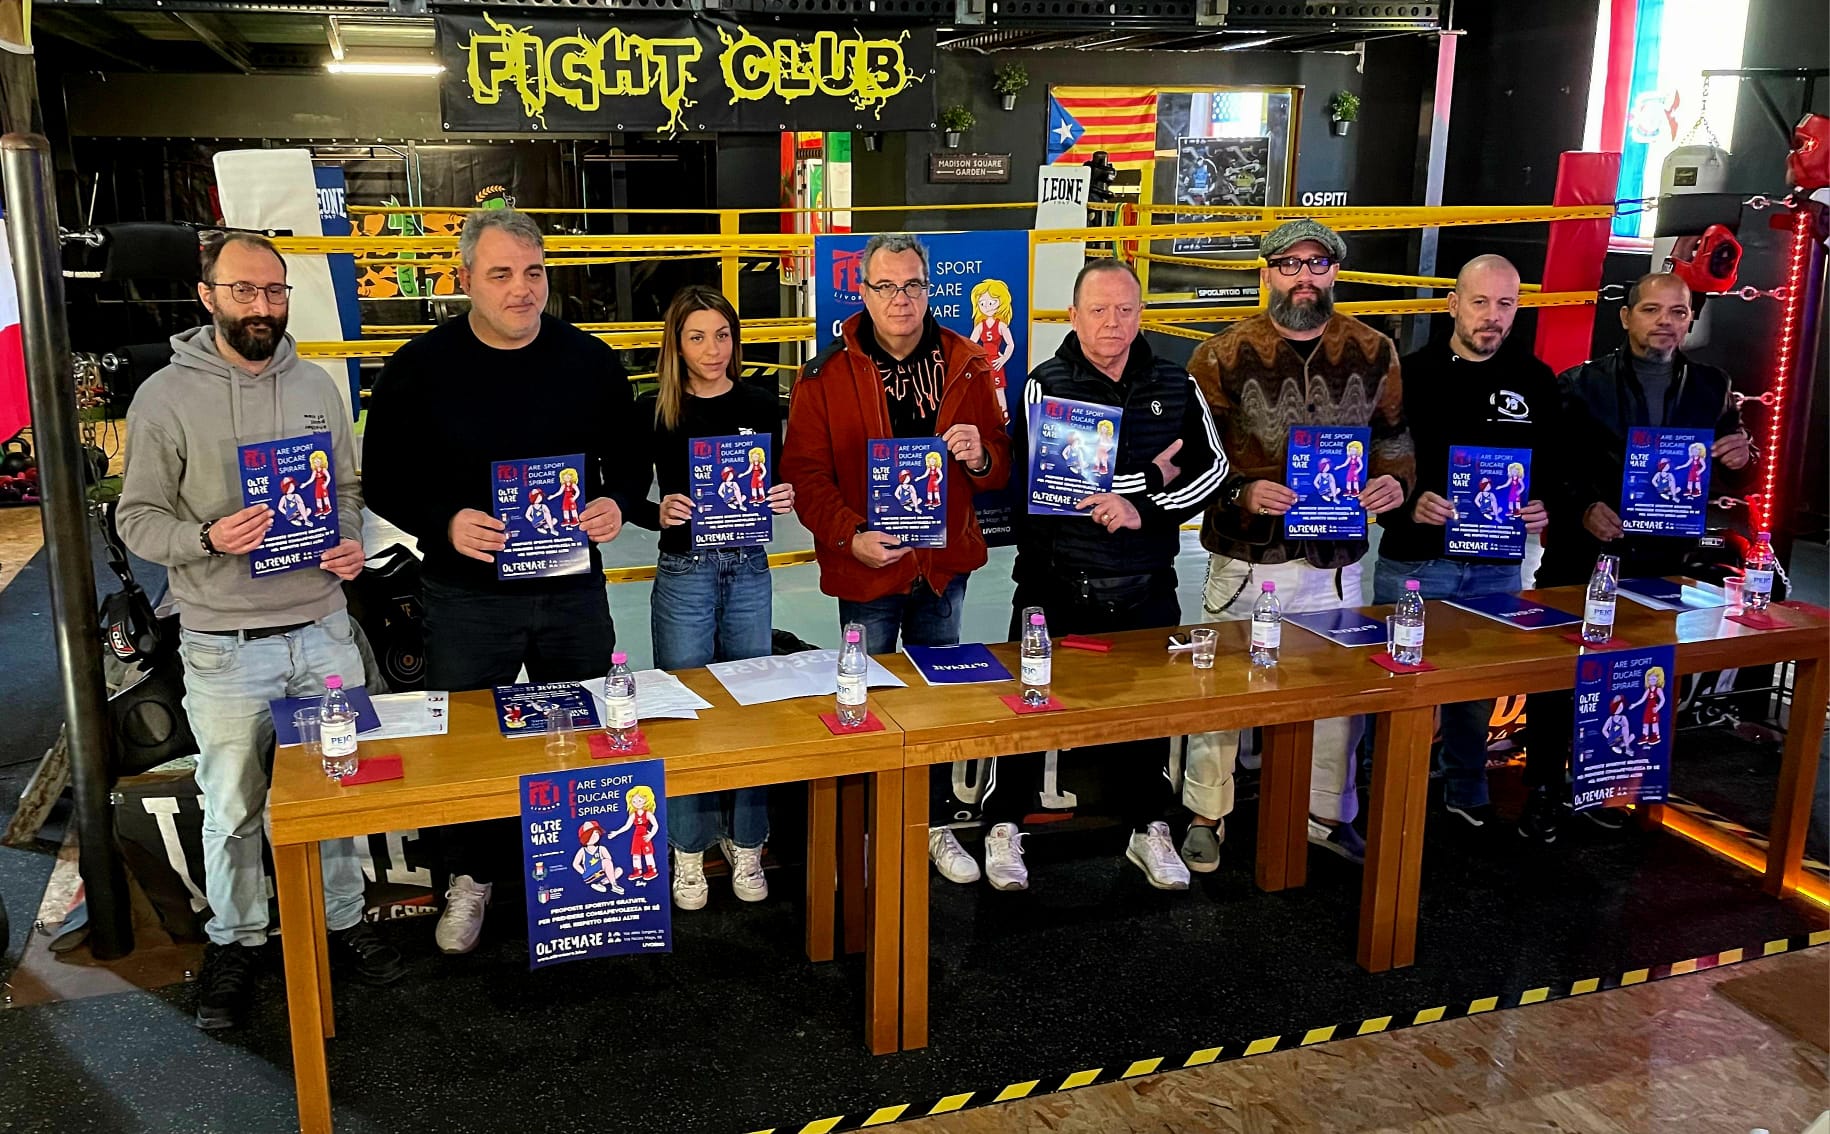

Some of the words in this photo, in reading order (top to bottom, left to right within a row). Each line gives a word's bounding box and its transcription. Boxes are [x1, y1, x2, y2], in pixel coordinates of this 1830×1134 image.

[460, 25, 702, 132] FIGHT
[717, 27, 912, 112] CLUB
[956, 168, 986, 176] GARDEN
[1042, 178, 1083, 205] LEONE
[317, 188, 347, 218] EONE
[1302, 191, 1347, 206] OSPITI
[936, 260, 982, 275] SPORT
[402, 268, 413, 294] CLA
[928, 283, 962, 297] CARE
[931, 304, 960, 318] ARE
[292, 443, 313, 453] SPORT
[278, 455, 306, 465] DUCARE
[279, 464, 306, 474] SPIRARE
[247, 476, 269, 488] OLTRE
[498, 487, 519, 496] OLTRE
[1033, 491, 1071, 505] OLTREMARE
[983, 526, 1011, 535] LIVORNO
[1289, 525, 1327, 533] OLTREMARE
[1623, 520, 1663, 529] OLTREMARE
[696, 532, 734, 543] OLTREMARE
[1449, 541, 1488, 550] OLTREMARE
[255, 552, 301, 570] OLTREMARE
[503, 560, 547, 573] OLTREMARE
[932, 662, 989, 671] OLTREMARE
[1630, 657, 1652, 667] SPORT
[1613, 670, 1642, 680] DUCARE
[1611, 681, 1640, 691] SPIRARE
[1579, 692, 1600, 704] OLTRE
[331, 735, 352, 745] PEJO
[601, 775, 633, 787] SPORT
[577, 790, 620, 804] DUCARE
[1575, 787, 1615, 806] OLTREMARE
[578, 803, 619, 817] SPIRARE
[530, 819, 562, 834] OLTRE
[551, 905, 583, 915] PROPOSTE
[585, 901, 615, 910] SPORTIVE
[538, 918, 550, 926] PER
[552, 913, 584, 922] PRENDERE
[586, 906, 643, 918] CONSAPEVOLEZZA
[573, 919, 602, 928] RISPETTO
[536, 932, 603, 956] OLTREMARE
